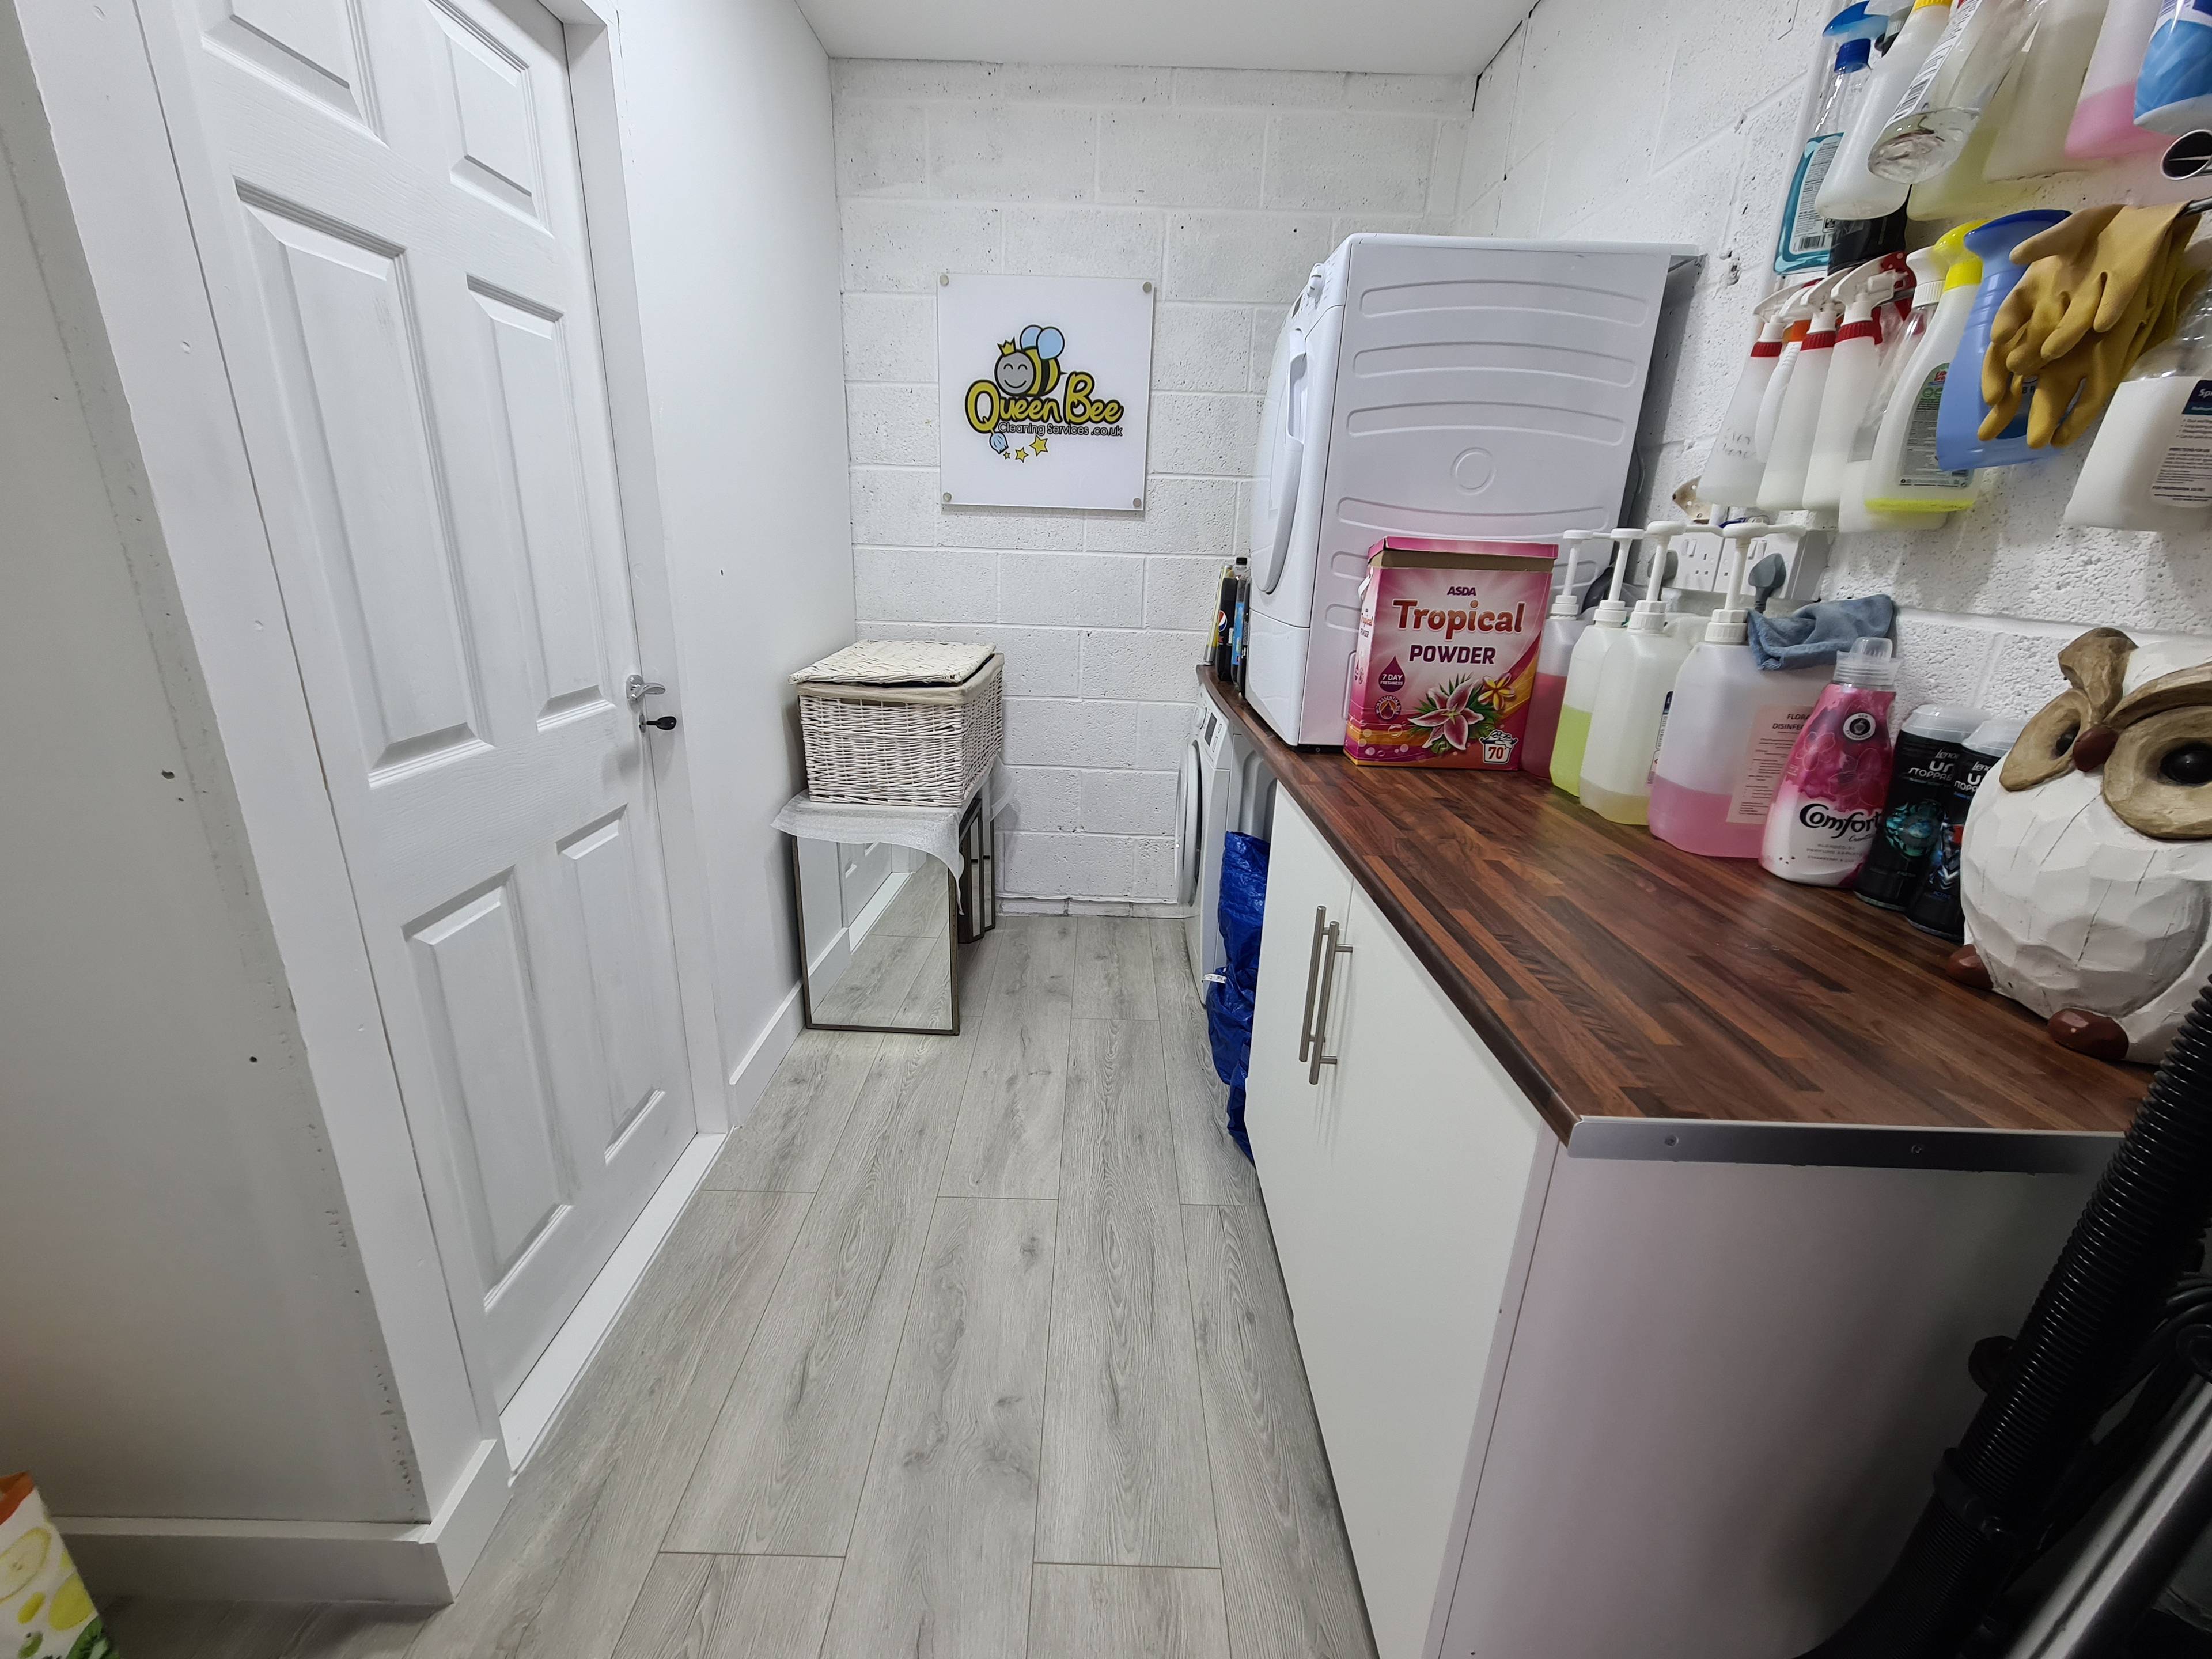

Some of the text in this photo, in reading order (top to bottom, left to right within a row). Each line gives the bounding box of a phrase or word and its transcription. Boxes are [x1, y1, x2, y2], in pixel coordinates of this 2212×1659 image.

[965, 371, 1124, 434] Queen Bee
[998, 422, 1123, 436] Cleaning Services .co.uk
[1447, 586, 1476, 596] ASDA
[1393, 599, 1525, 641] Tropical
[1408, 645, 1497, 664] POWDER
[1488, 747, 1504, 759] 70
[1800, 803, 1881, 839] Comfort
